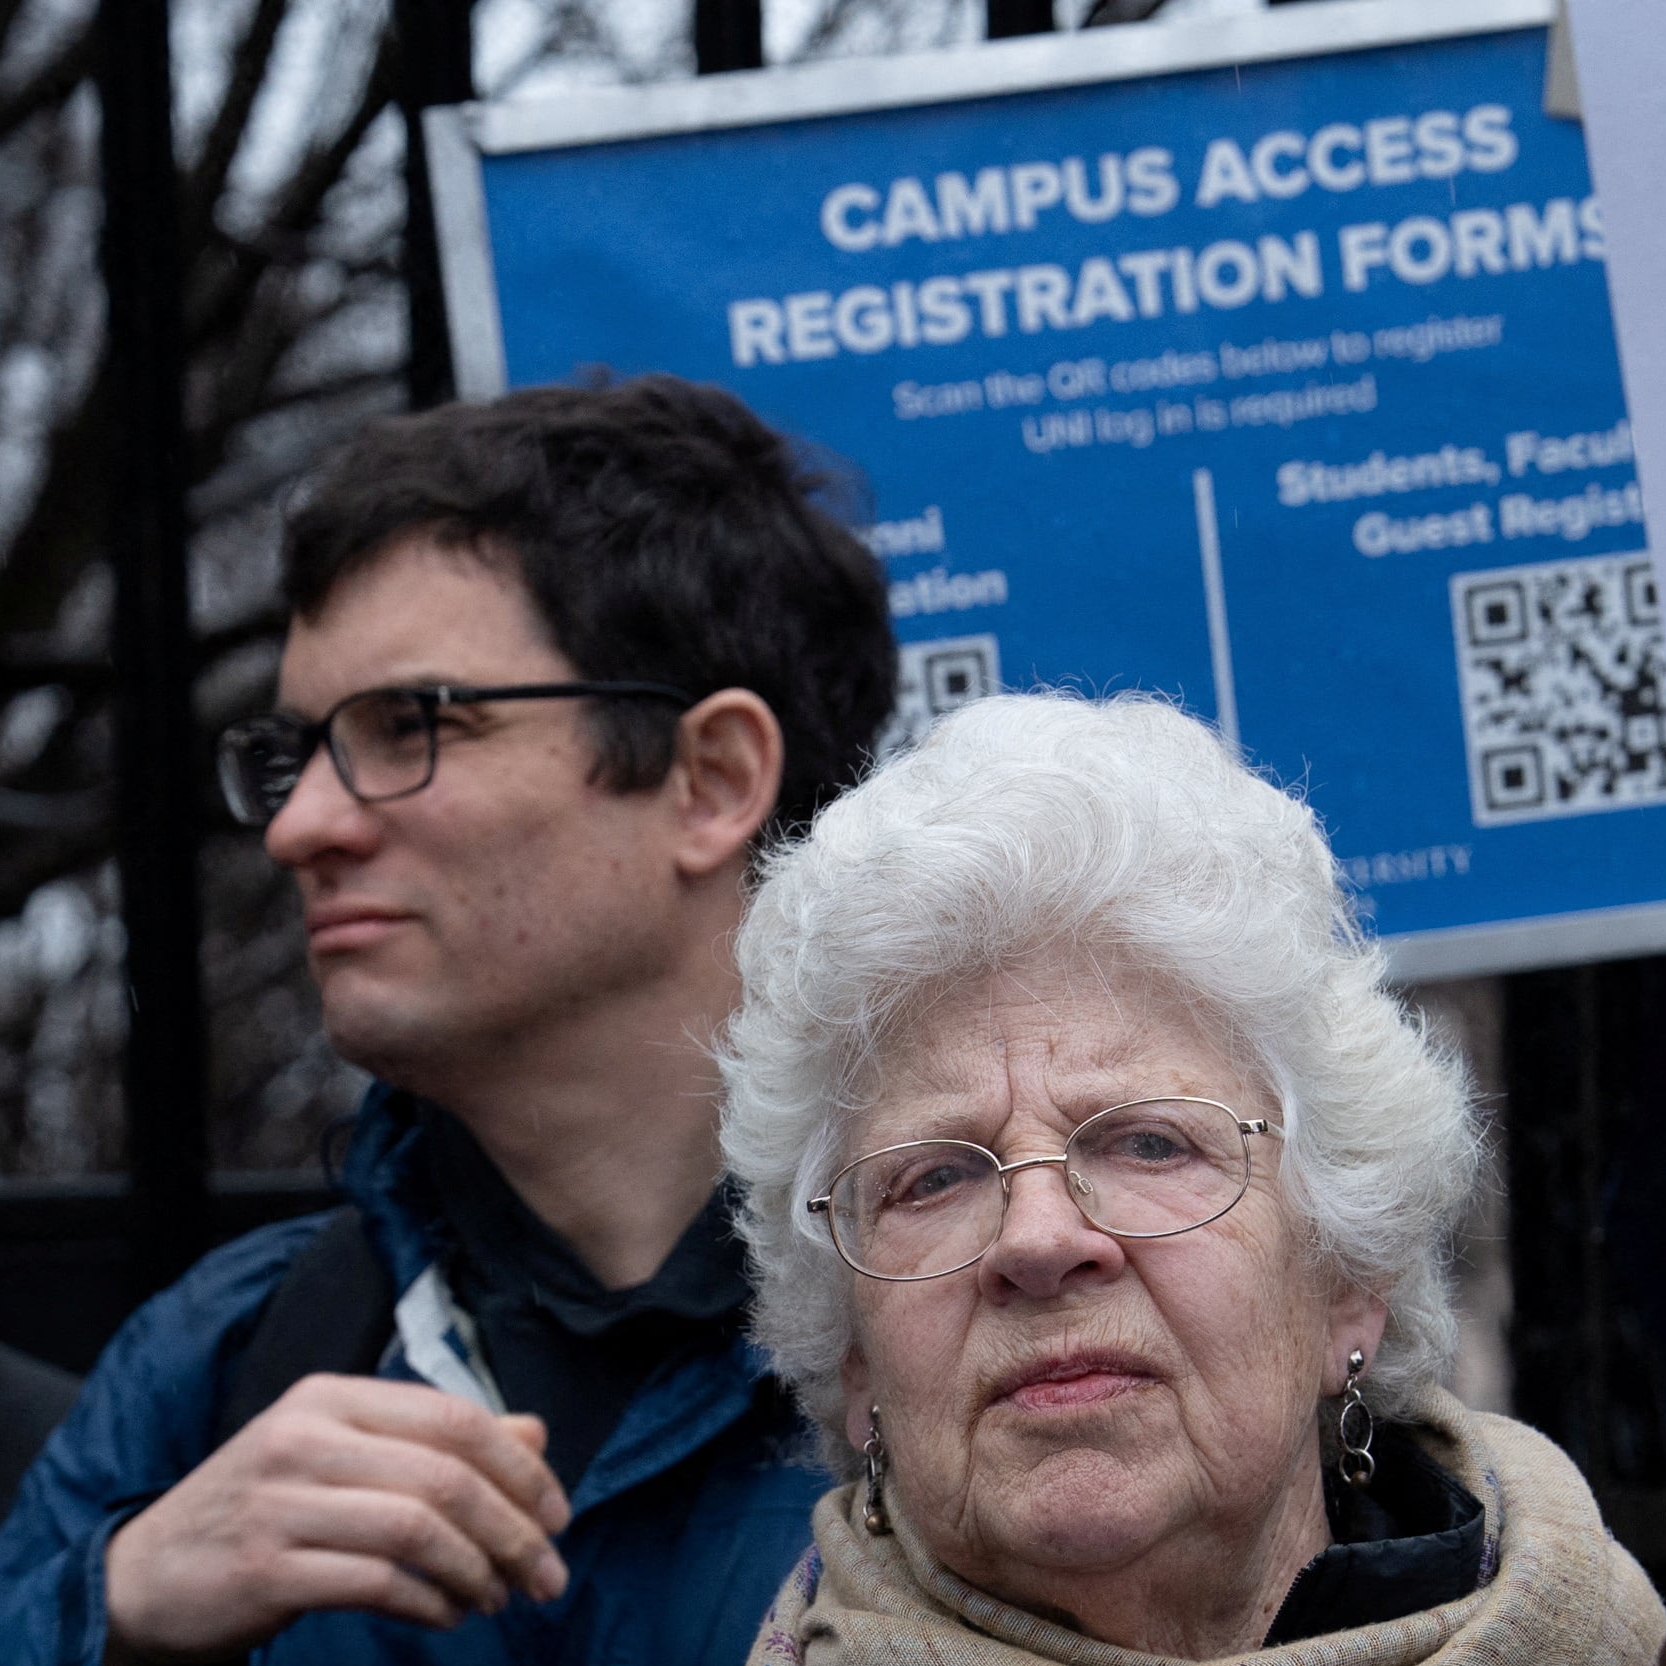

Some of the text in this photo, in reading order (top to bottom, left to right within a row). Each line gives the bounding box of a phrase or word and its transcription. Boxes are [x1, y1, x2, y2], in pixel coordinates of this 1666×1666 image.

[820, 103, 1520, 252] CAMPUS ACCESS
[728, 228, 1324, 368] REGISTRATION
[892, 313, 1505, 421] Scan the QR codes below to register
[1094, 402, 1156, 449] log
[1230, 372, 1377, 430] required
[1277, 444, 1501, 507] Students,
[1353, 502, 1493, 557] Guest
